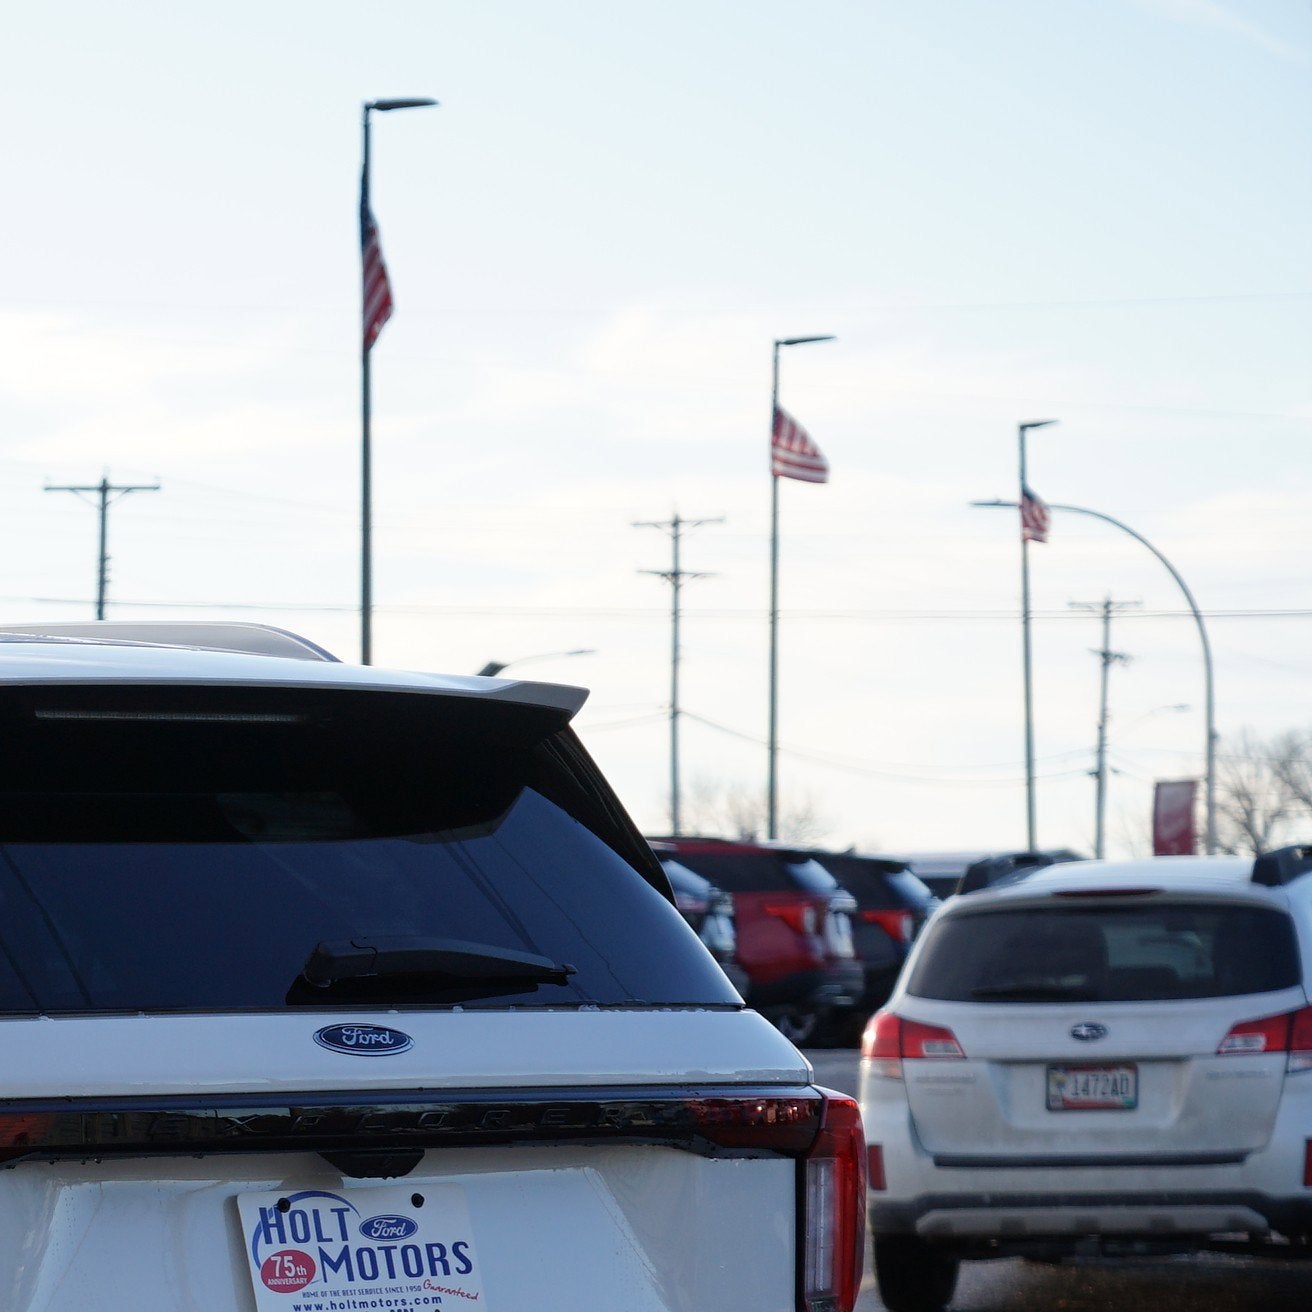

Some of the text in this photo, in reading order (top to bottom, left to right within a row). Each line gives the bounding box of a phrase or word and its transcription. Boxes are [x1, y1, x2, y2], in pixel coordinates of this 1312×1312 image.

[341, 1026, 394, 1045] Ford
[258, 1207, 350, 1245] HOLT
[270, 1256, 308, 1277] 75th
[318, 1241, 473, 1284] MOTORS
[267, 1277, 308, 1286] ANNIVERSARY
[422, 1278, 479, 1302] Guaranteed
[302, 1291, 319, 1299] HOME
[342, 1289, 357, 1297] BEST
[357, 1287, 384, 1296] SERVICE
[384, 1286, 405, 1295] SINCE
[405, 1285, 422, 1293] 1950
[292, 1295, 443, 1312] www.holtmotors.com
